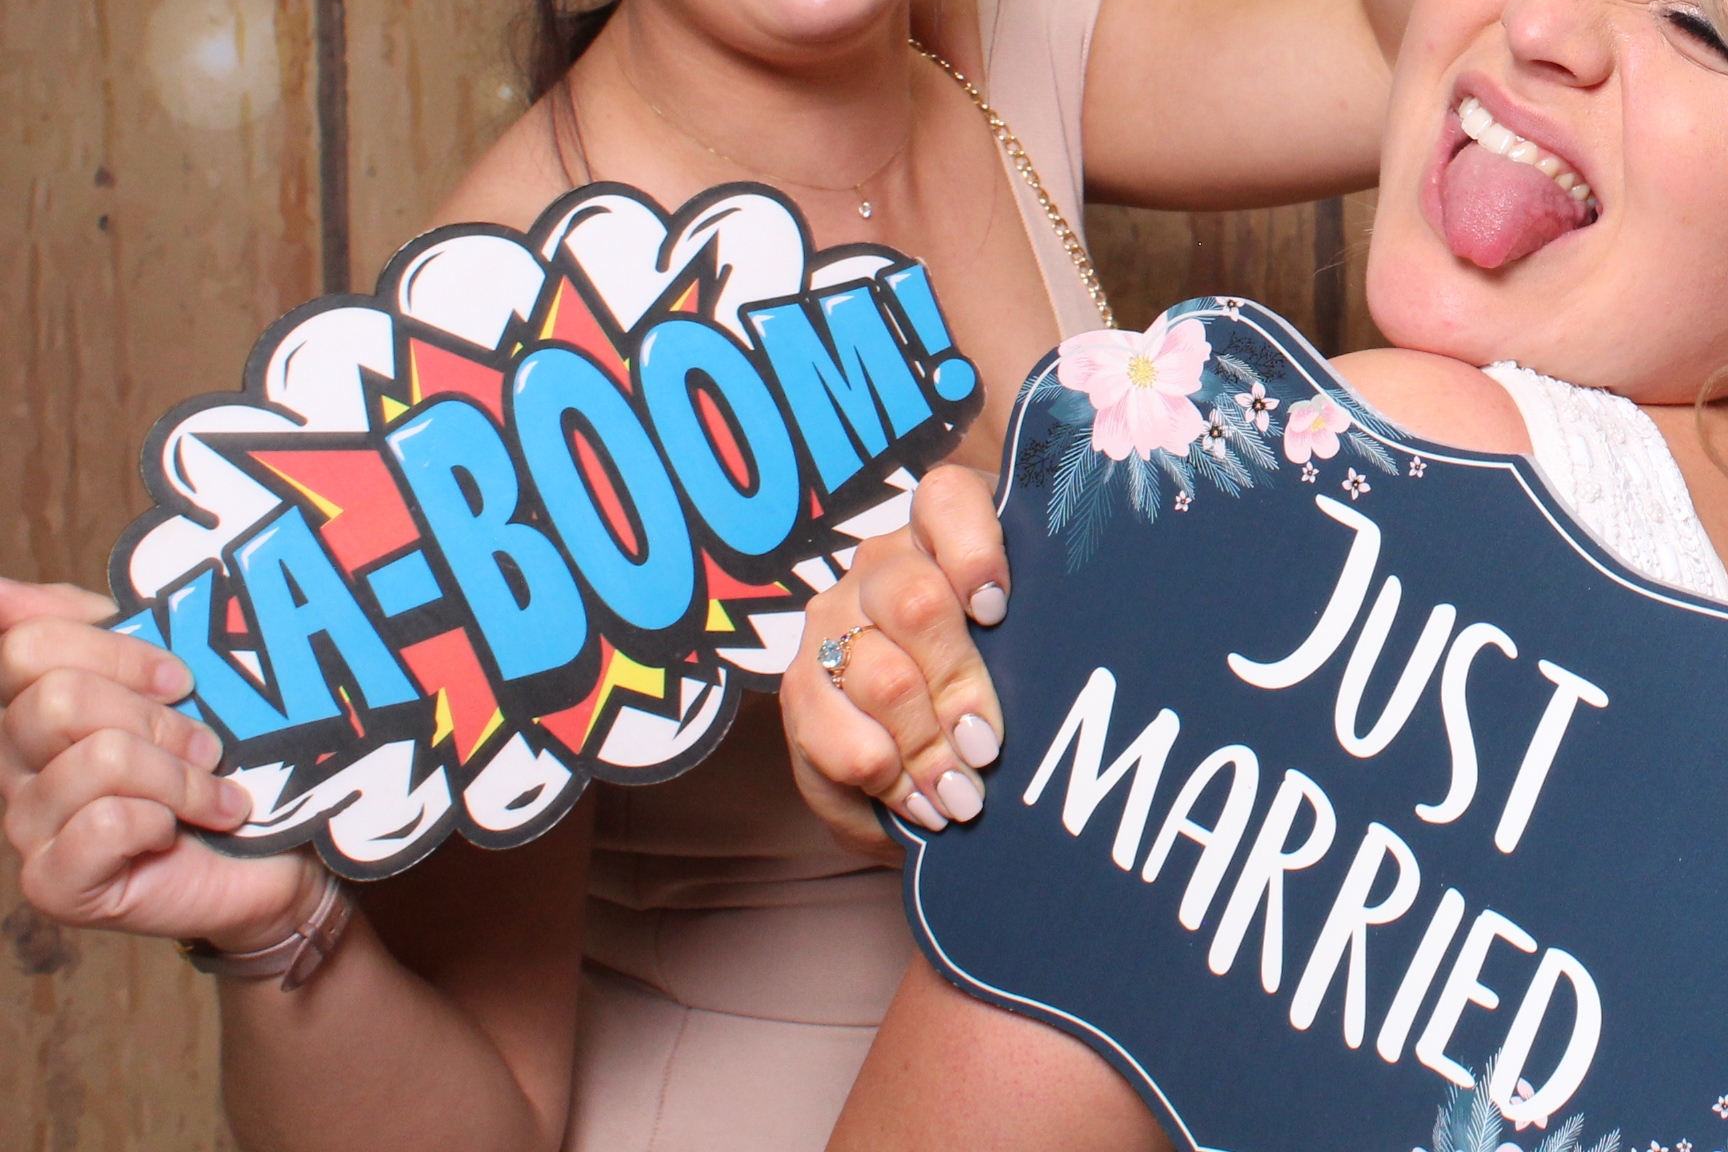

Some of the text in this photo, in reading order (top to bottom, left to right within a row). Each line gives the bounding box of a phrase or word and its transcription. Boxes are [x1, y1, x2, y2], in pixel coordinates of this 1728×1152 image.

[108, 264, 976, 741] KA-BOOM!
[1227, 494, 1609, 853] JUST
[1023, 666, 1603, 1122] MARRIED
